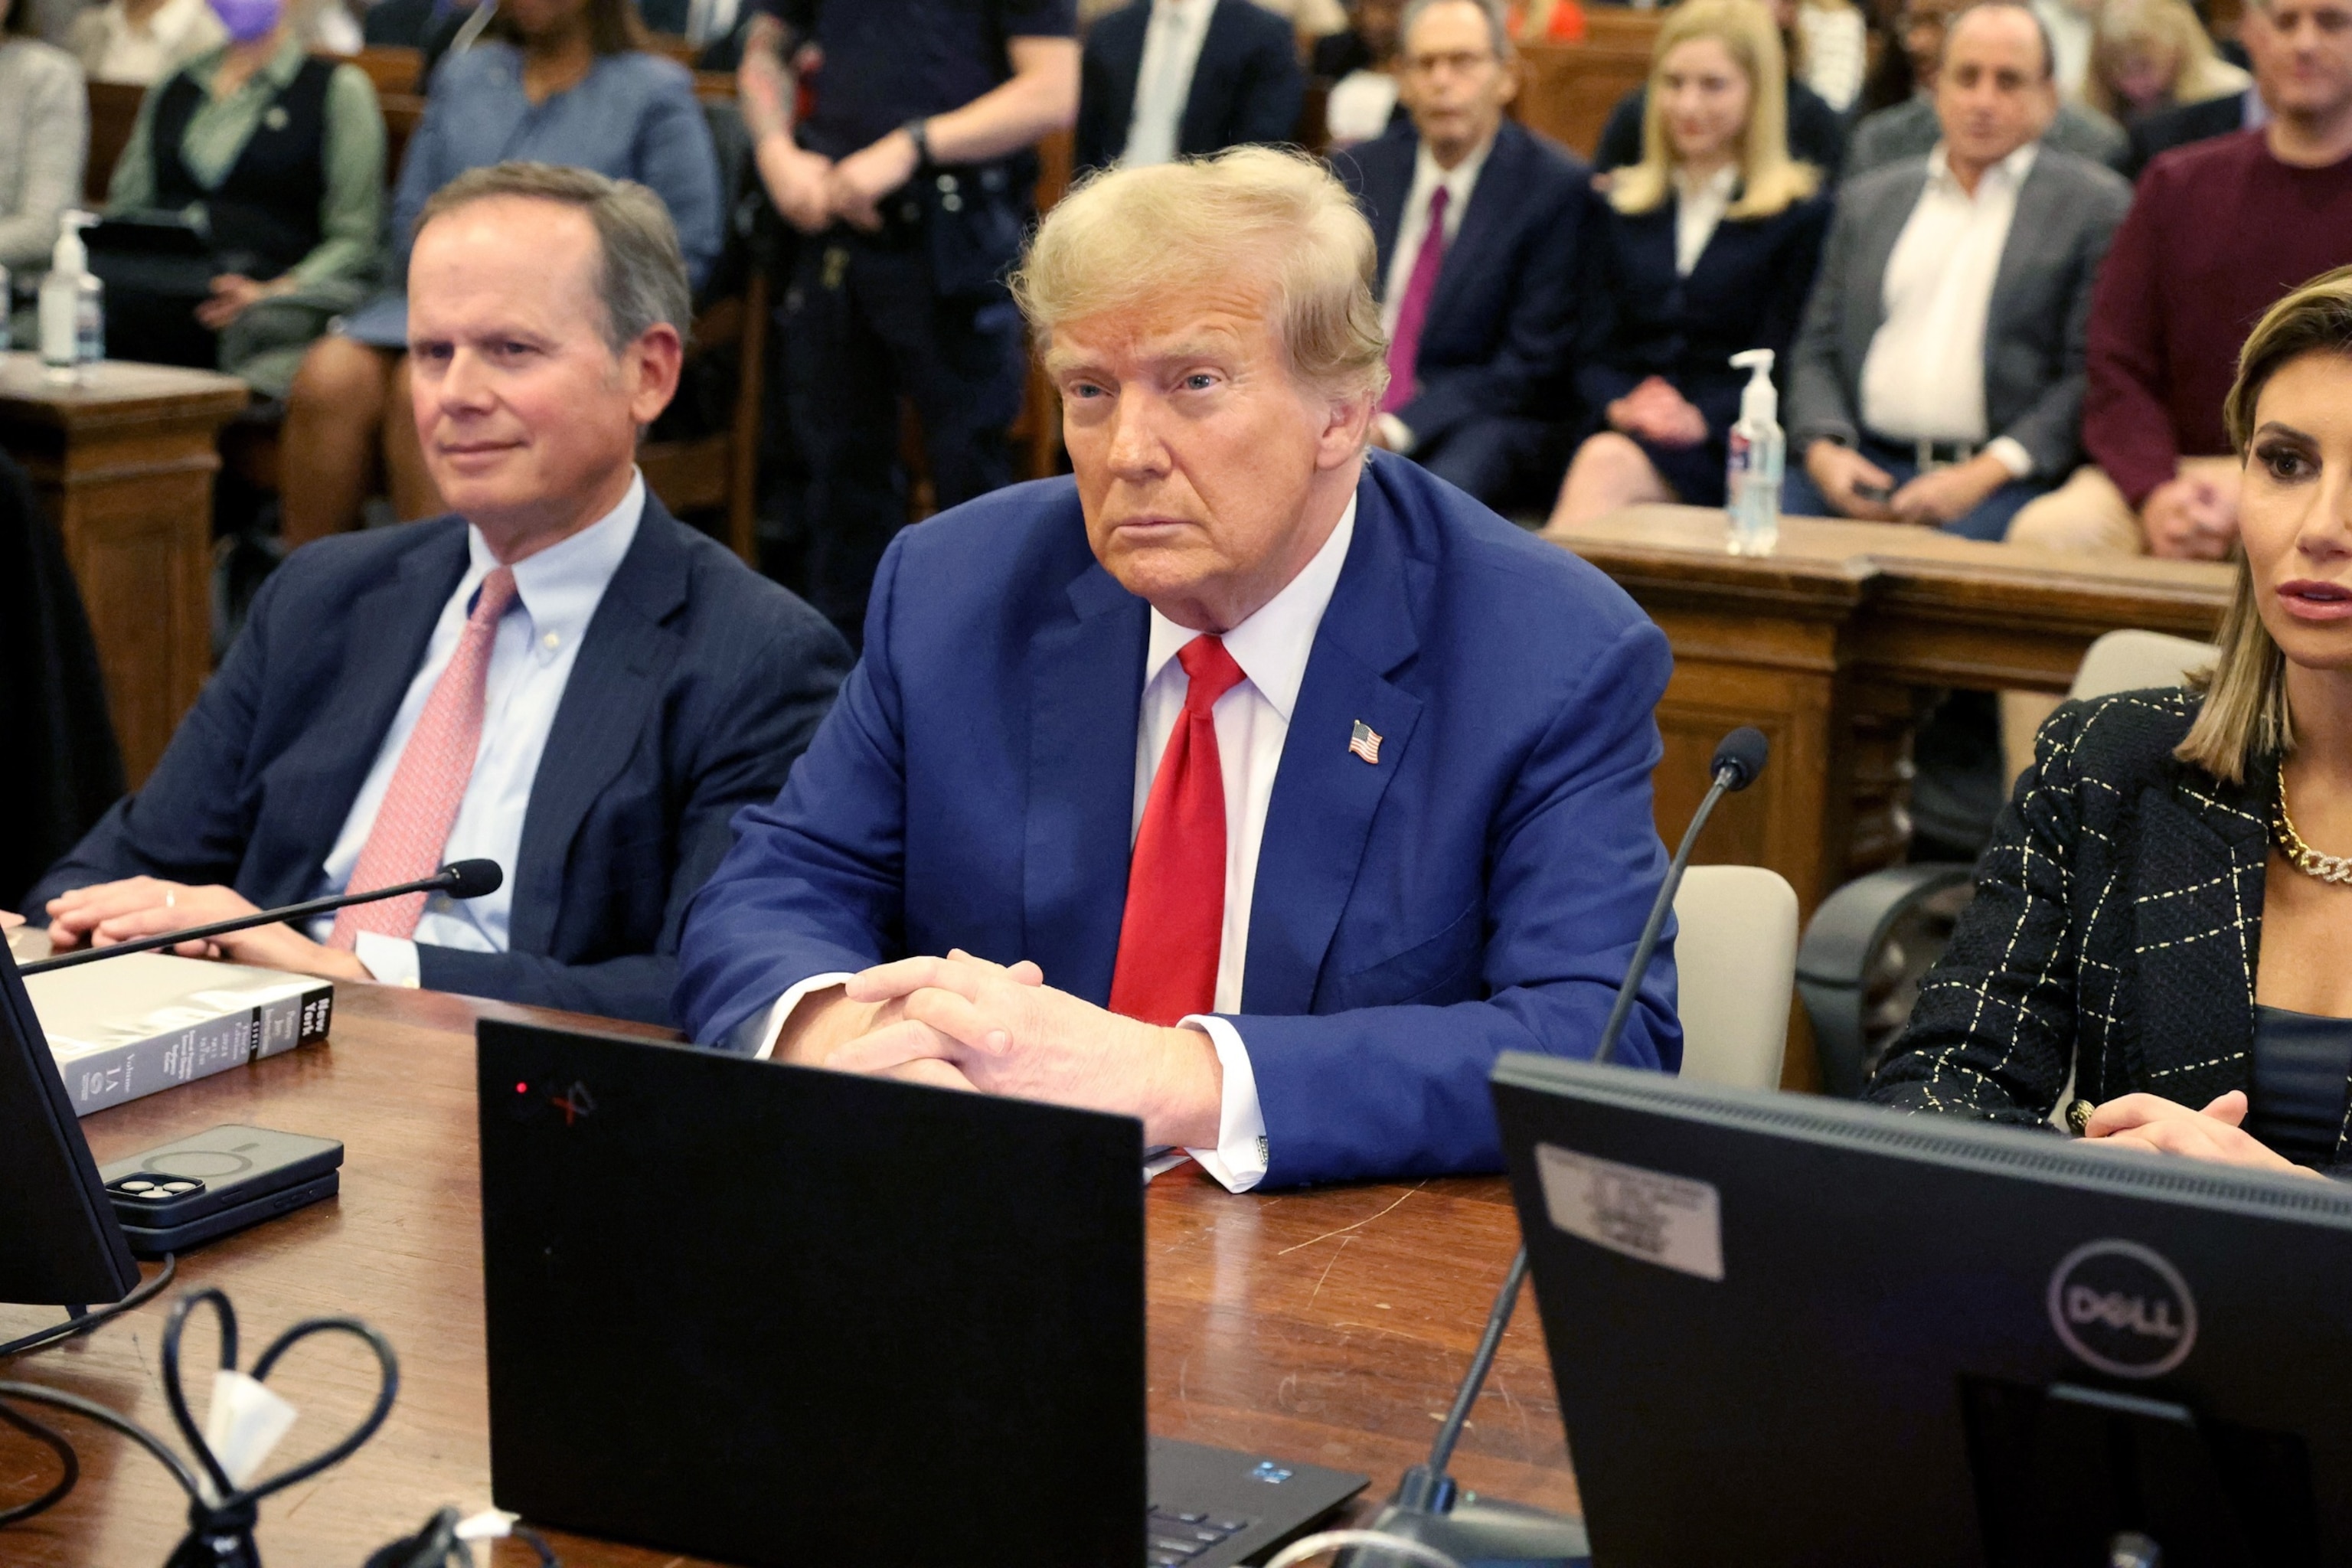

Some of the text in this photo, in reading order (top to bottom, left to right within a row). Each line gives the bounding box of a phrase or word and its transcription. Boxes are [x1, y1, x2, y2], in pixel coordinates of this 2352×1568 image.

[302, 1001, 317, 1036] York
[315, 998, 329, 1032] New
[2068, 1285, 2179, 1337] DELL
